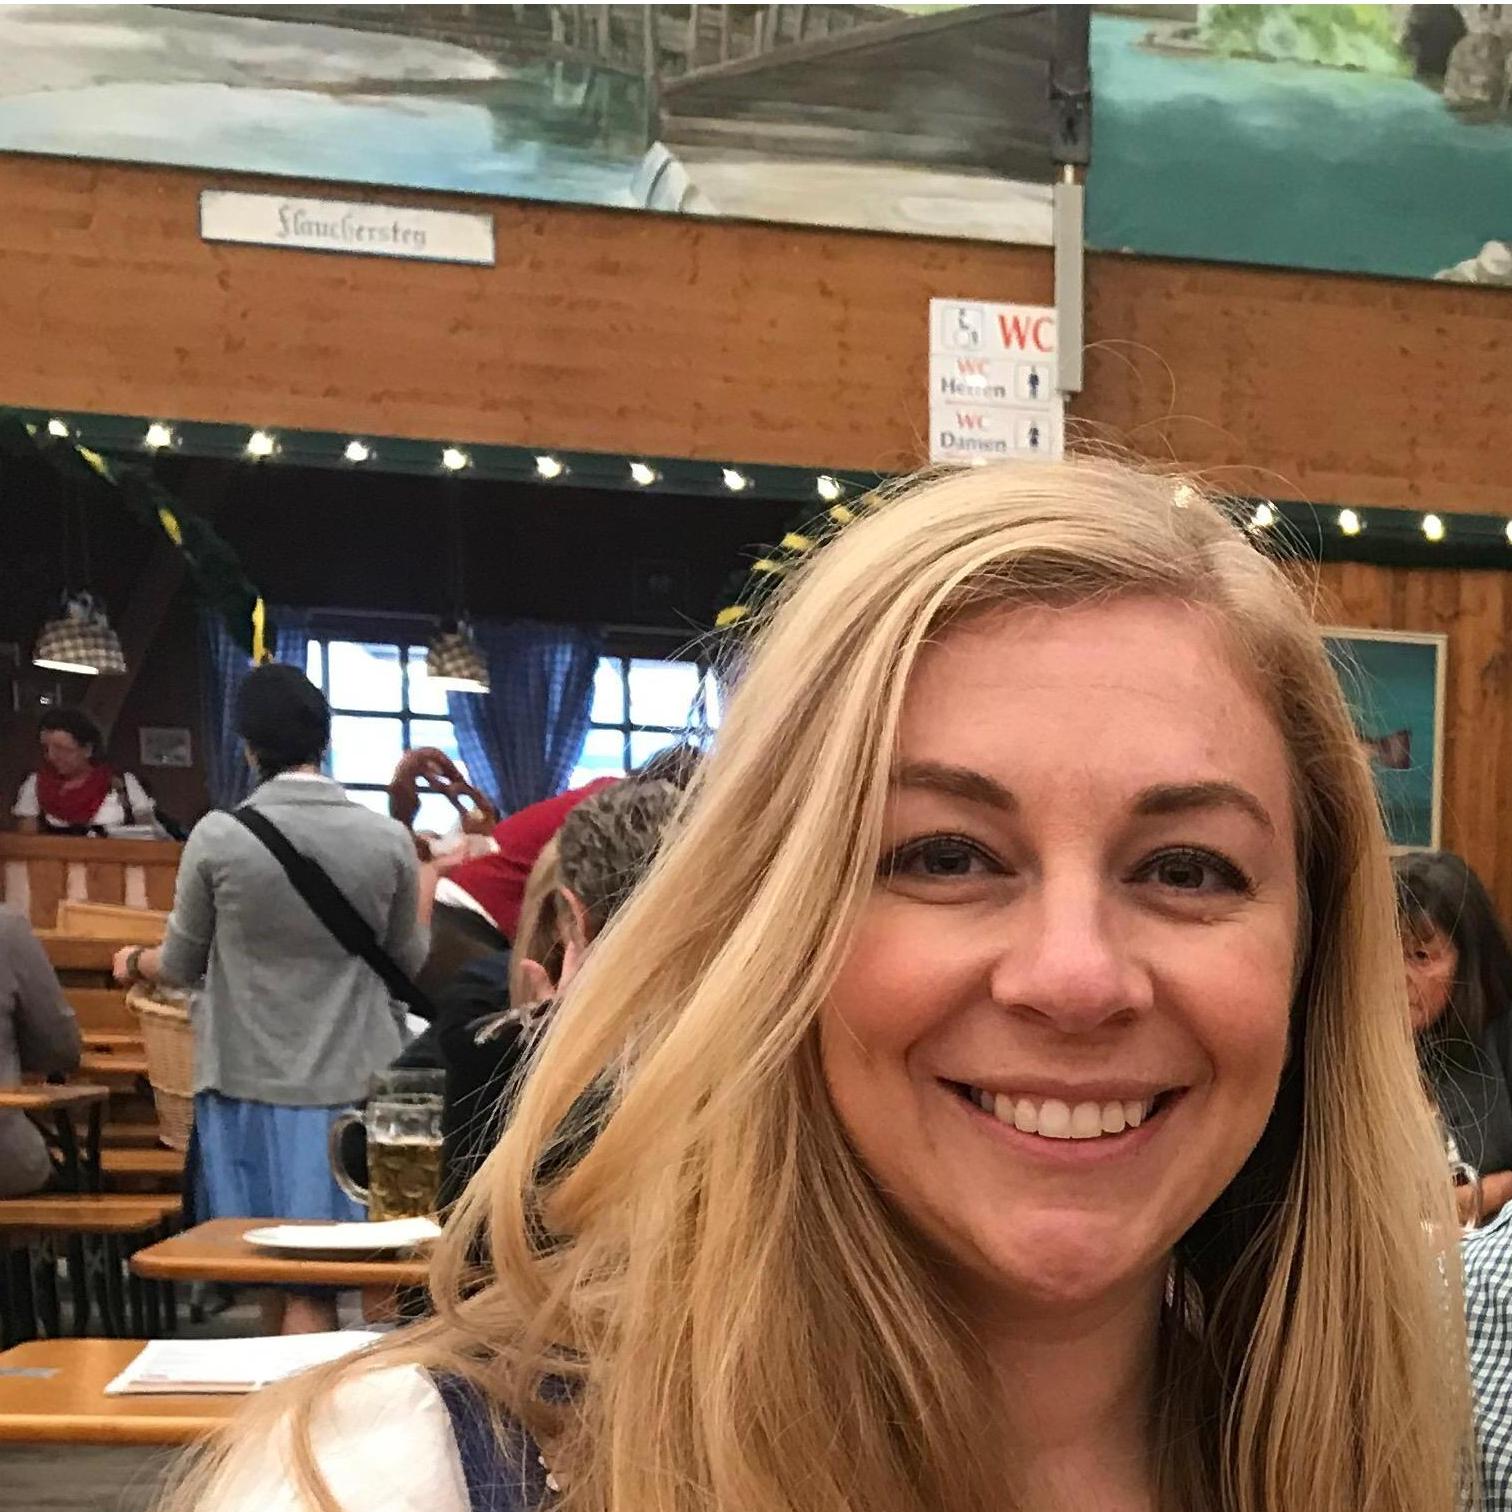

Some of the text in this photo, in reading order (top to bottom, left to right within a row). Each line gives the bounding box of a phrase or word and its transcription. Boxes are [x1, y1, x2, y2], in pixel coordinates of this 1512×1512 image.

[998, 314, 1055, 353] WC
[956, 357, 989, 375] WC
[940, 376, 1006, 399] Herren
[956, 411, 987, 430] WC
[940, 431, 1007, 453] Damen
